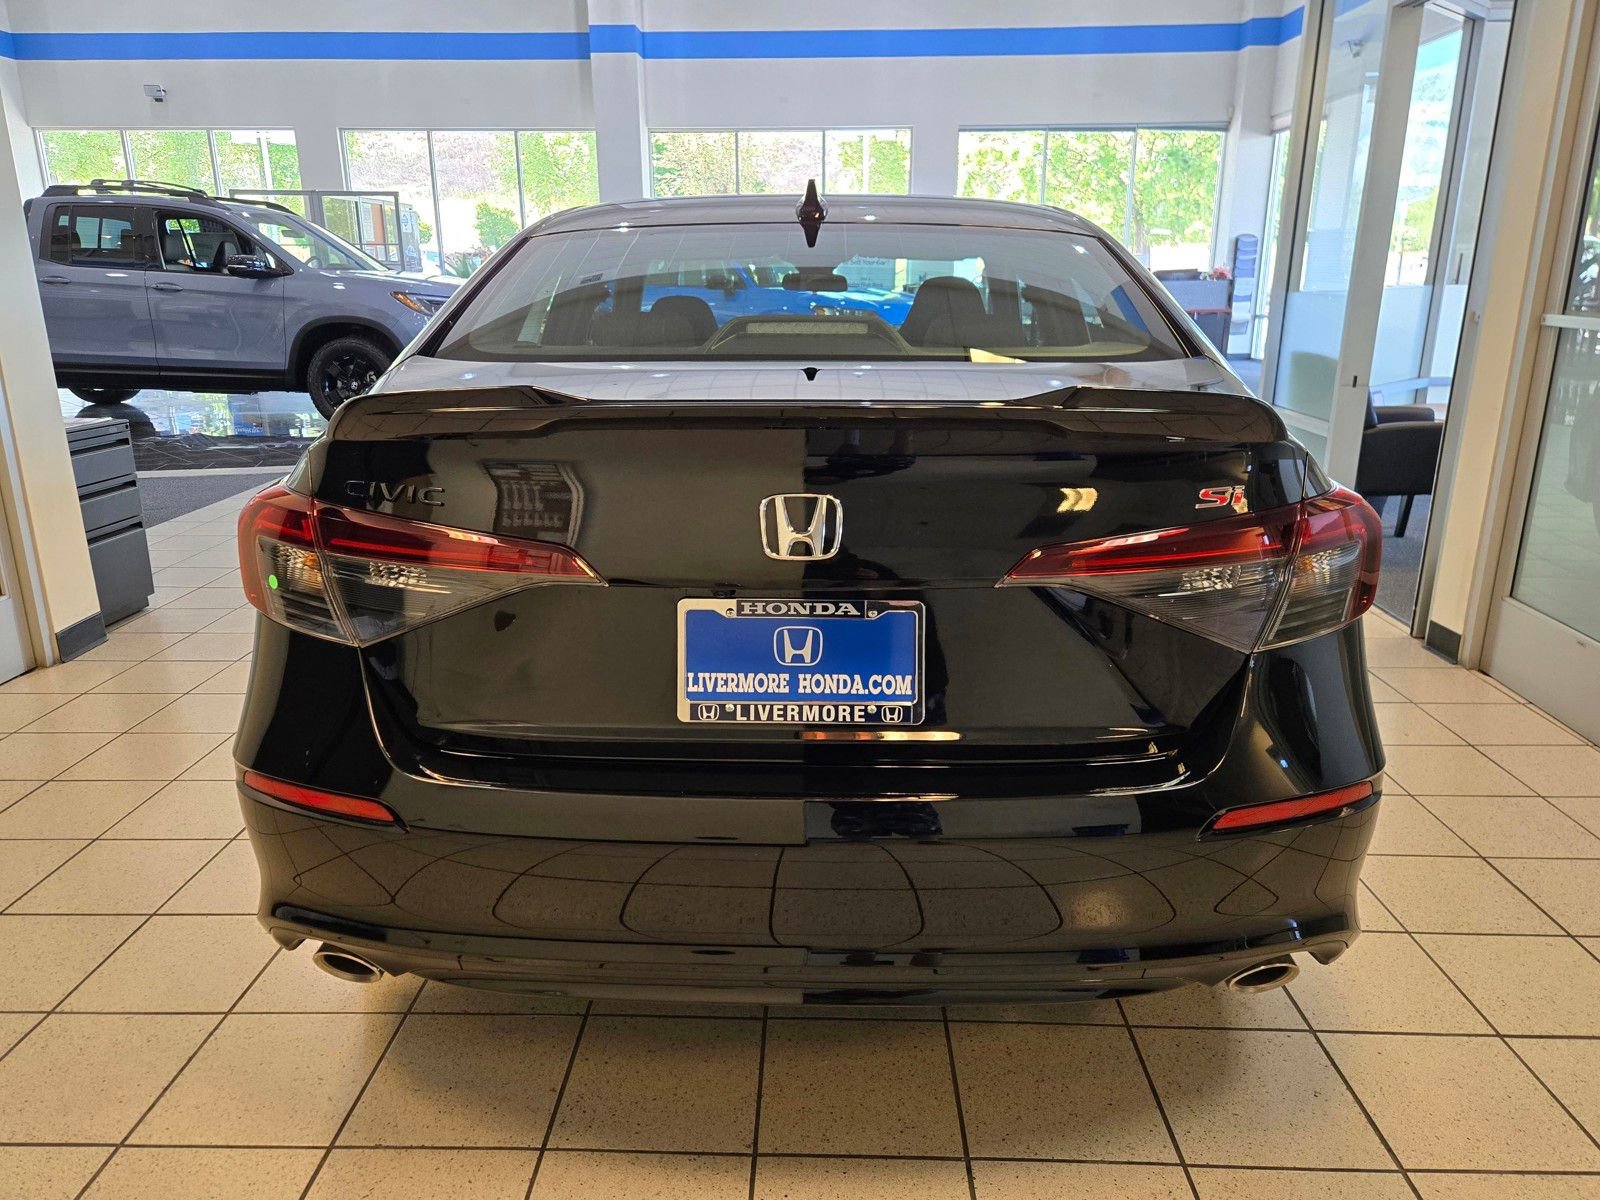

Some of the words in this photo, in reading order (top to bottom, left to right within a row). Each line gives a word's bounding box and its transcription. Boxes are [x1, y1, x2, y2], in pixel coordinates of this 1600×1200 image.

[345, 480, 444, 506] CIVIC
[1196, 486, 1245, 508] Si
[741, 603, 861, 615] HONDA
[687, 672, 789, 693] LIVERMORE
[798, 673, 912, 695] HONDA.COM
[736, 704, 866, 722] LIVERMORE
